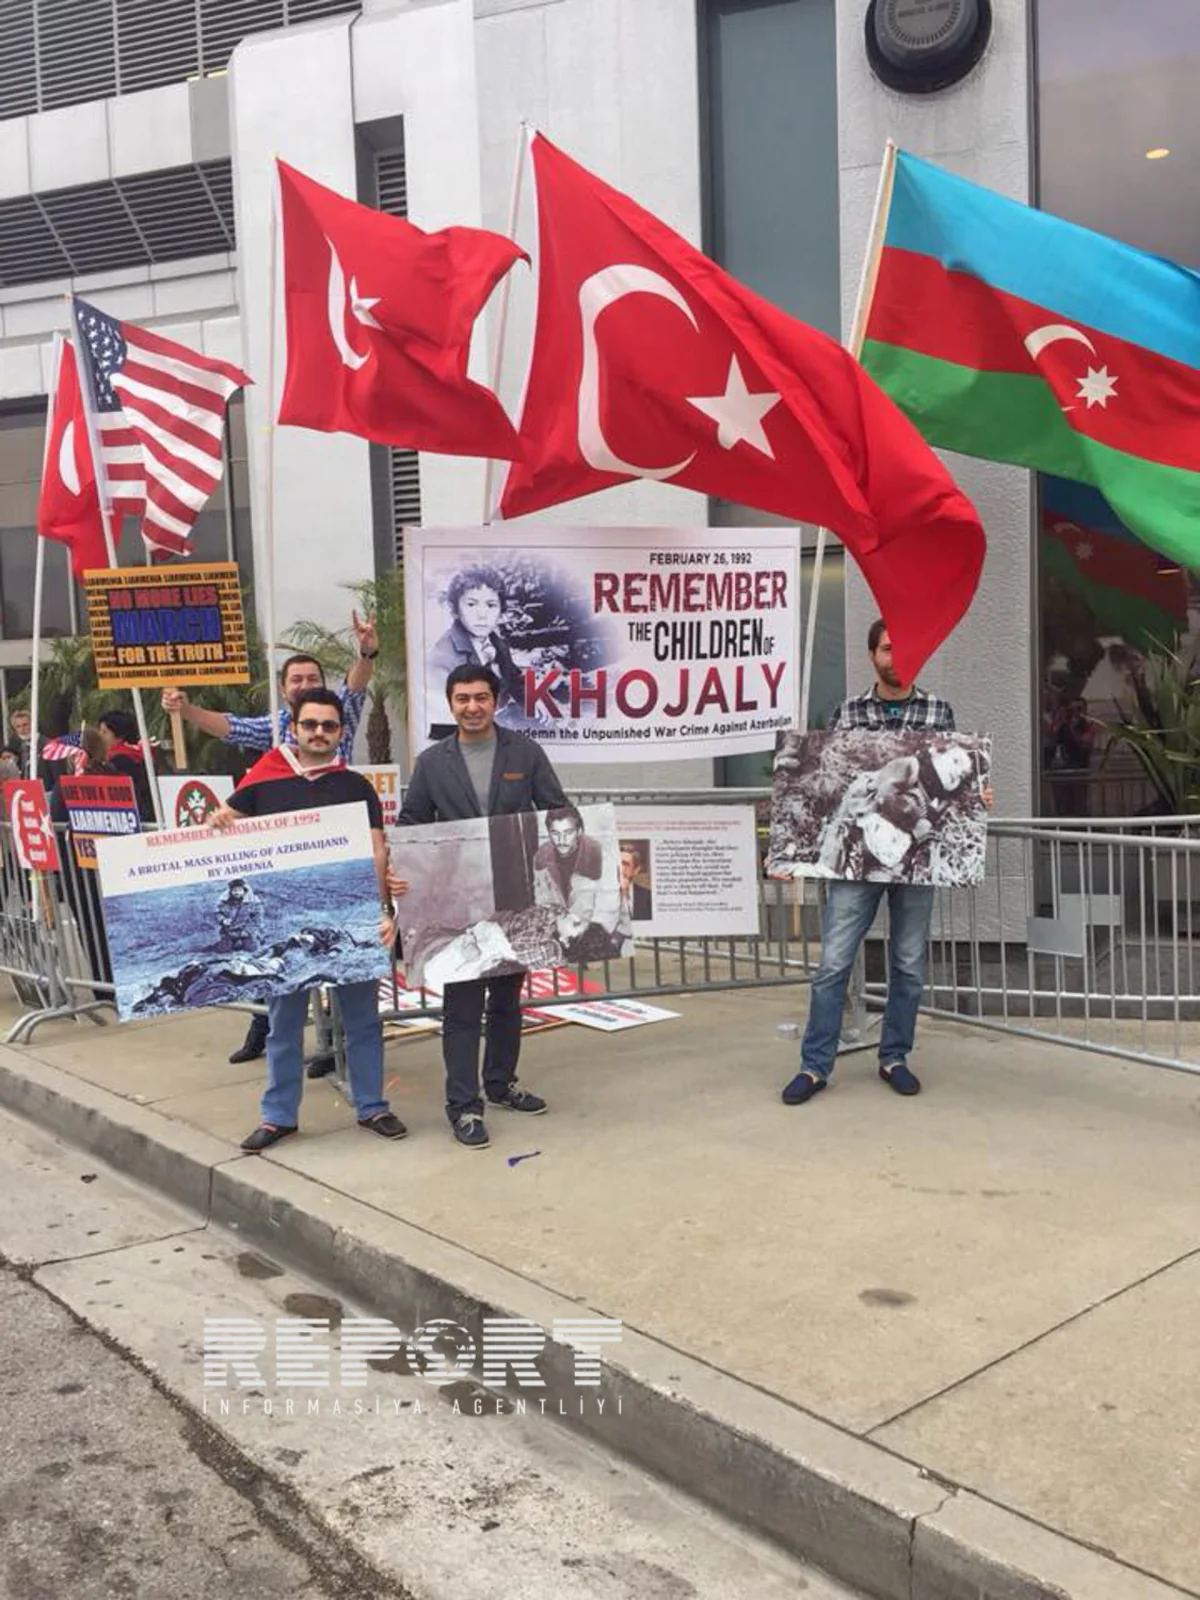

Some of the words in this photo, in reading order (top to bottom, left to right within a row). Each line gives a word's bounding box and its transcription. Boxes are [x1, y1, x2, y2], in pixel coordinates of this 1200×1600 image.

[649, 553, 710, 566] FEBRUARY
[713, 553, 729, 566] 26,
[731, 552, 753, 565] 1992
[109, 588, 131, 609] NO
[134, 587, 181, 608] MORE
[183, 585, 218, 606] LIES
[593, 570, 788, 615] REMEMBER
[112, 606, 221, 645] MARCH
[628, 621, 652, 642] THE
[654, 618, 763, 661] CHILDREN
[763, 636, 775, 655] OF
[117, 647, 145, 664] FOR
[147, 645, 176, 664] THE
[177, 643, 224, 662] TRUTH
[524, 662, 787, 720] KHOJALY
[515, 727, 556, 740] ndemn
[560, 727, 579, 740] the
[582, 725, 651, 742] Unpunished
[655, 724, 677, 738] War
[681, 722, 710, 737] Crime
[712, 721, 748, 735] Against
[750, 716, 792, 731] Azerbaijan
[364, 773, 398, 793] ET
[68, 810, 138, 833] LIARMENIA?
[146, 829, 214, 848] REMEMBER
[219, 818, 273, 837] KHOJALY
[274, 817, 290, 829] OF
[292, 813, 321, 826] 1992
[75, 838, 97, 858] YES
[128, 868, 136, 878] A
[137, 861, 182, 877] BRUTAL
[184, 856, 214, 869] MASS
[215, 850, 258, 864] KILLING
[259, 847, 273, 858] OF
[275, 836, 350, 855] AZERBAIJANIS
[207, 868, 222, 878] BY
[223, 861, 275, 876] ARMENIA
